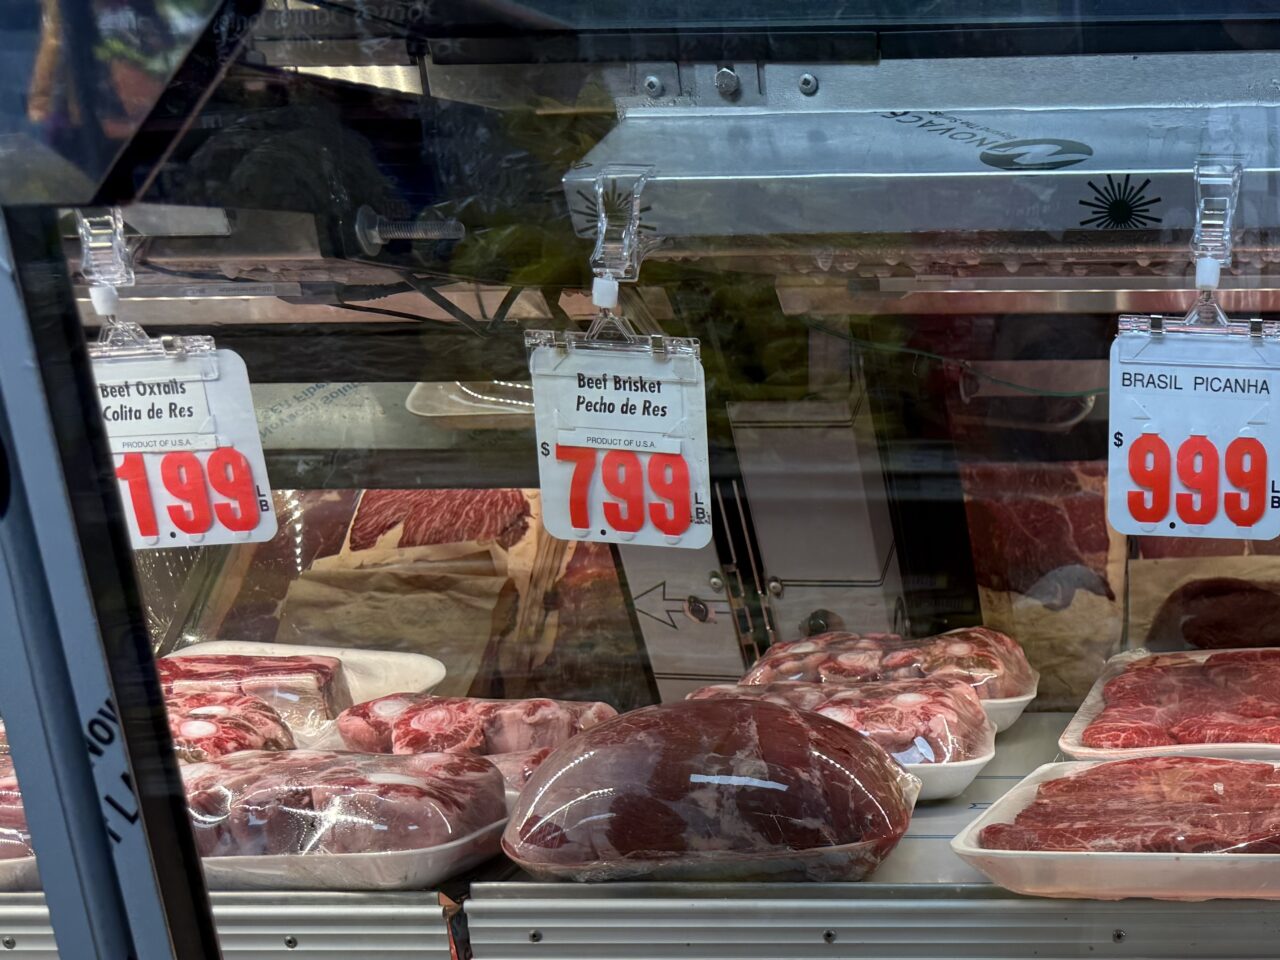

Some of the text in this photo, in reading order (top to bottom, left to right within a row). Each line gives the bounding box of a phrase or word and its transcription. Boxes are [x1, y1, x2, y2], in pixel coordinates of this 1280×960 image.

[101, 378, 186, 398] Beef Oxtails
[577, 373, 661, 393] Beef Brisket
[1122, 372, 1270, 394] BRASIL PICANHA
[103, 403, 193, 421] Colita de Res
[576, 396, 667, 416] Pecho de Res
[541, 442, 550, 456] $
[587, 437, 621, 445] PRODUCT
[1114, 432, 1123, 447] $
